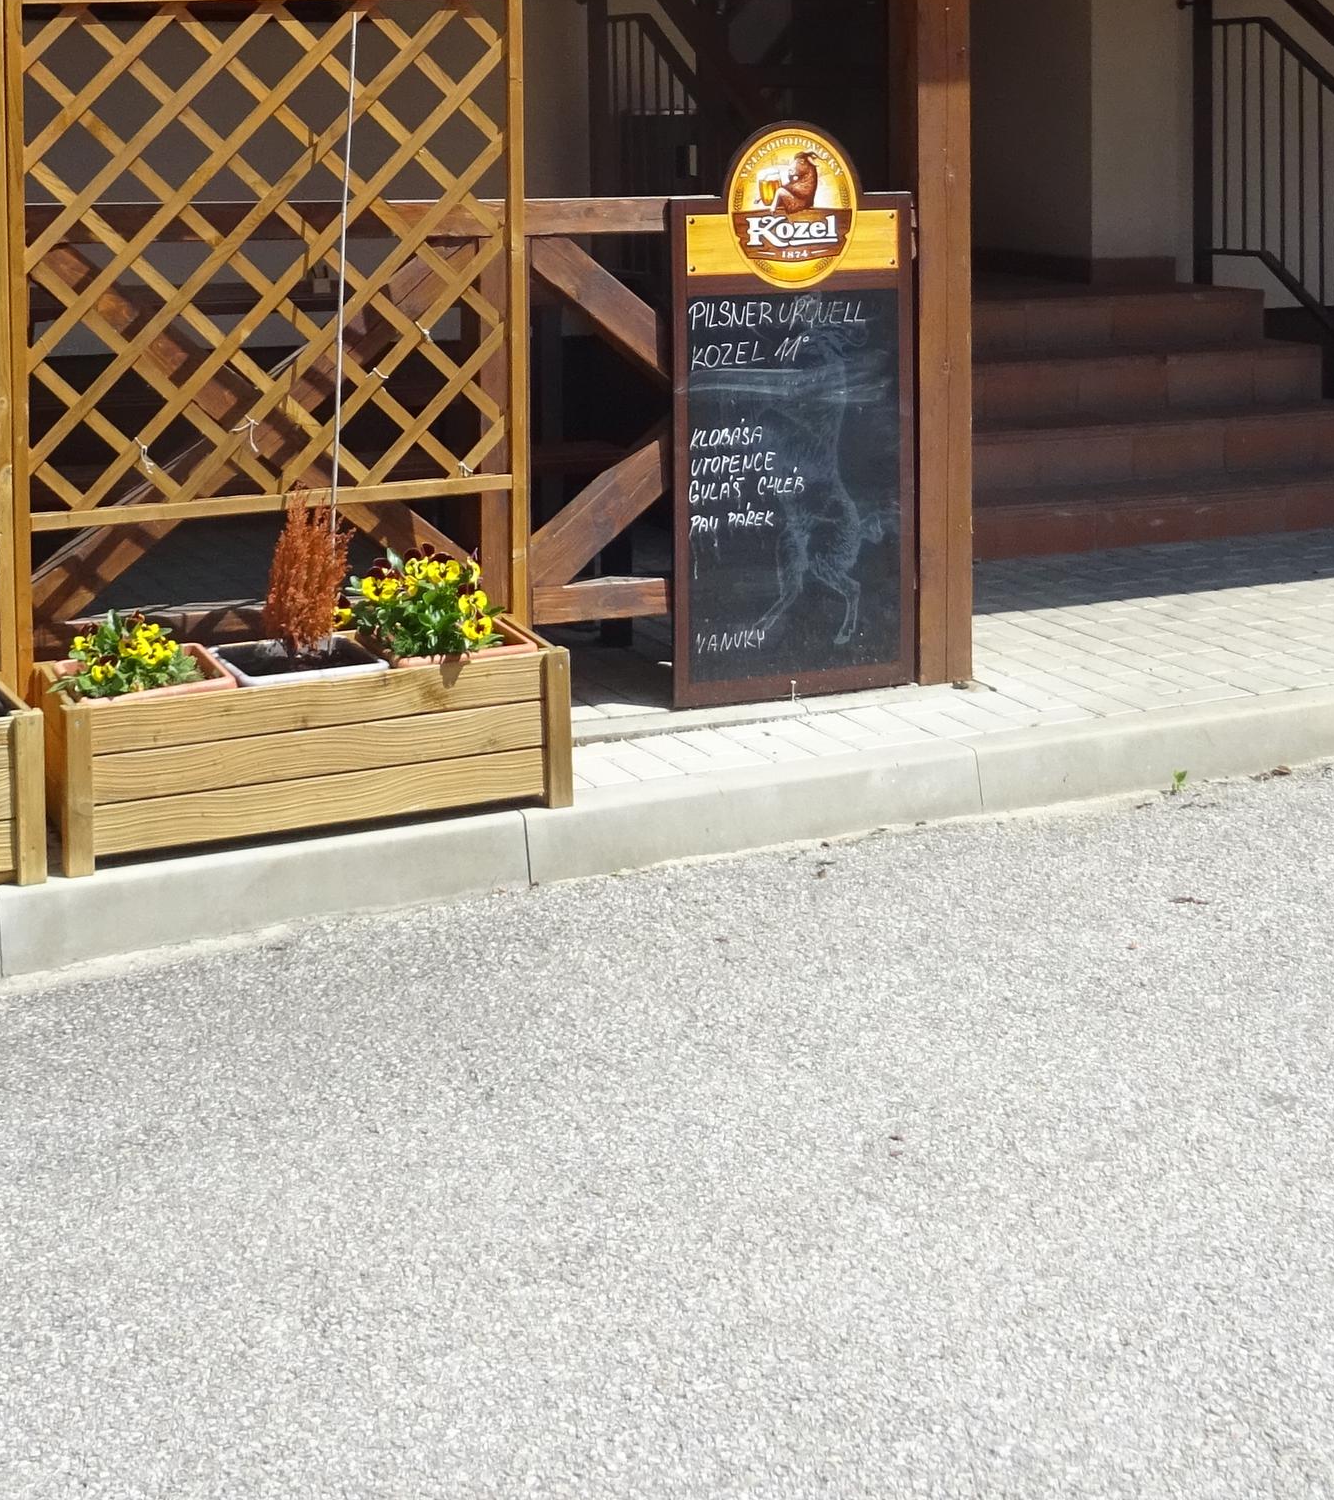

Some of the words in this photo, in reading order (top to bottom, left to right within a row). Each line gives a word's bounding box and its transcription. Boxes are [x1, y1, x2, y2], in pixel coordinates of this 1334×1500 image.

[746, 216, 838, 247] Kozel
[781, 250, 809, 259] 1874
[688, 301, 772, 330] PILSNER
[778, 300, 867, 330] URQUELL
[691, 341, 765, 370] KOZEL
[689, 418, 763, 450] KLOBÁSA
[691, 451, 776, 476] UTOPENCE
